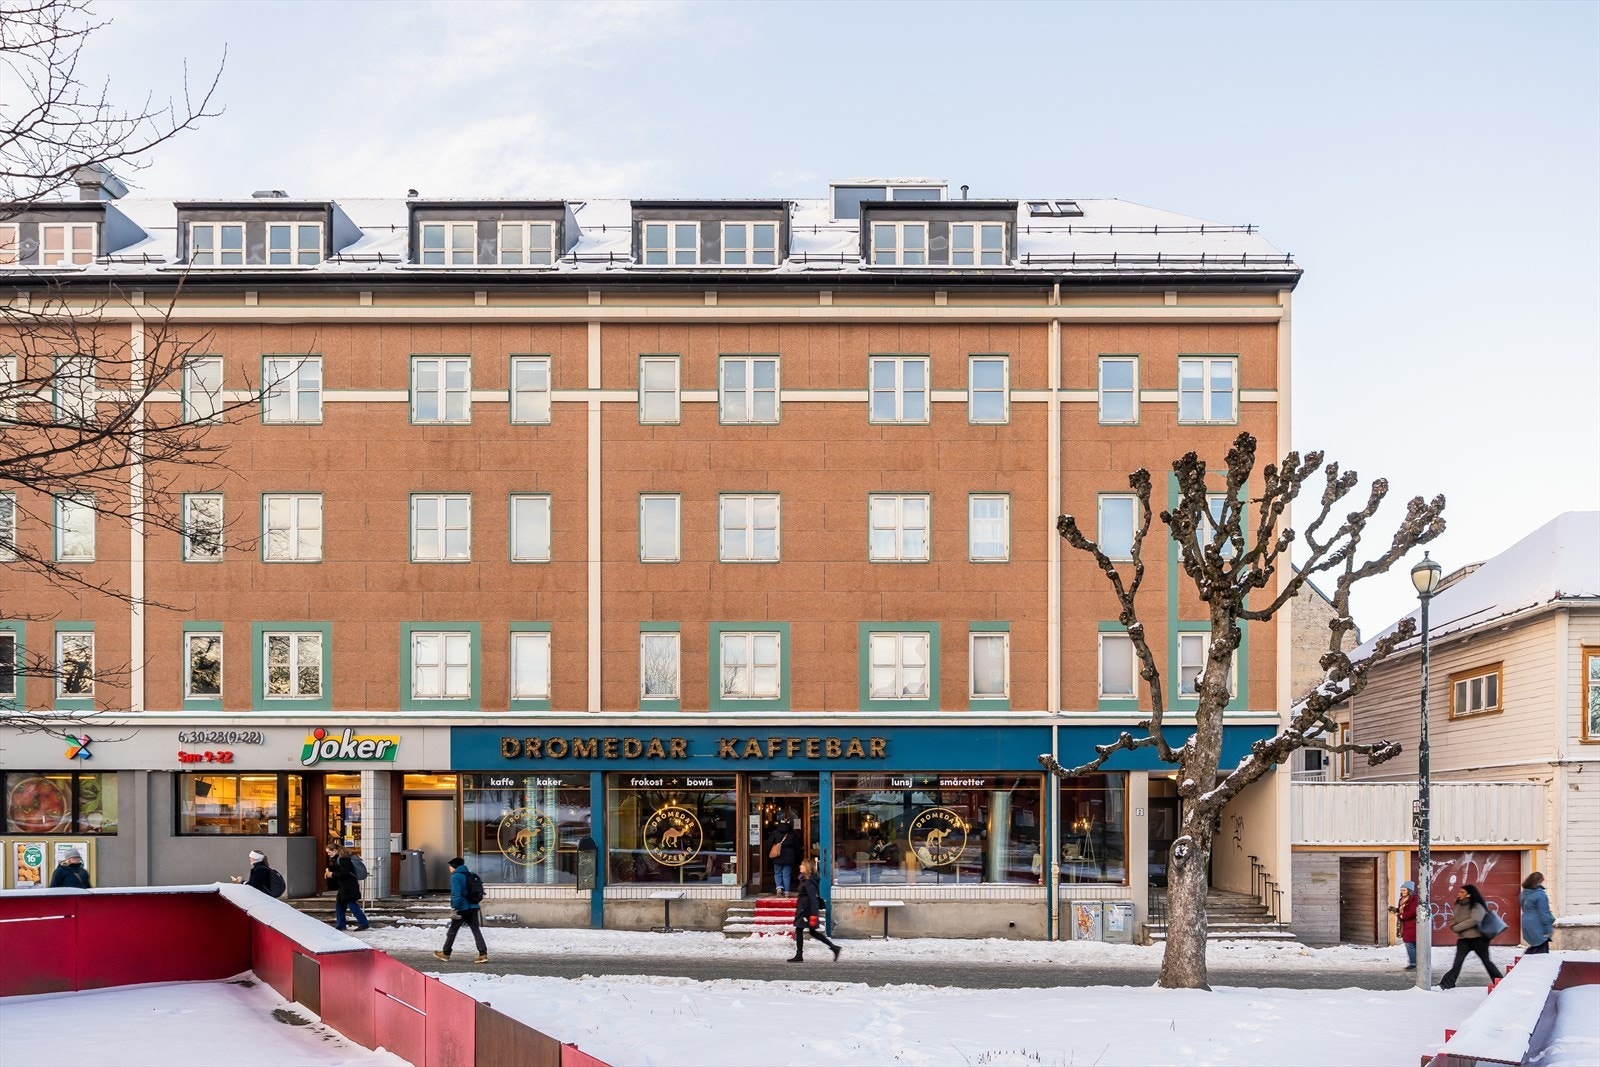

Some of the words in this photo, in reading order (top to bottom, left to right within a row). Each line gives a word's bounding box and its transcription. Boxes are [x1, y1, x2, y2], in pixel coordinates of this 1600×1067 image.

[302, 727, 392, 767] joker
[502, 737, 687, 758] DROMEDAR
[719, 737, 886, 758] KAFFEBAR
[490, 777, 515, 786] kaffe
[536, 777, 563, 786] kaker
[630, 777, 664, 786] frokost
[686, 777, 713, 786] bowls
[891, 777, 913, 788] lunsj
[939, 776, 985, 786] småretter
[651, 811, 695, 828] DROMEDAR
[916, 812, 960, 828] DROMEDAR
[26, 854, 36, 863] 16
[653, 846, 693, 861] KAFFEBAR
